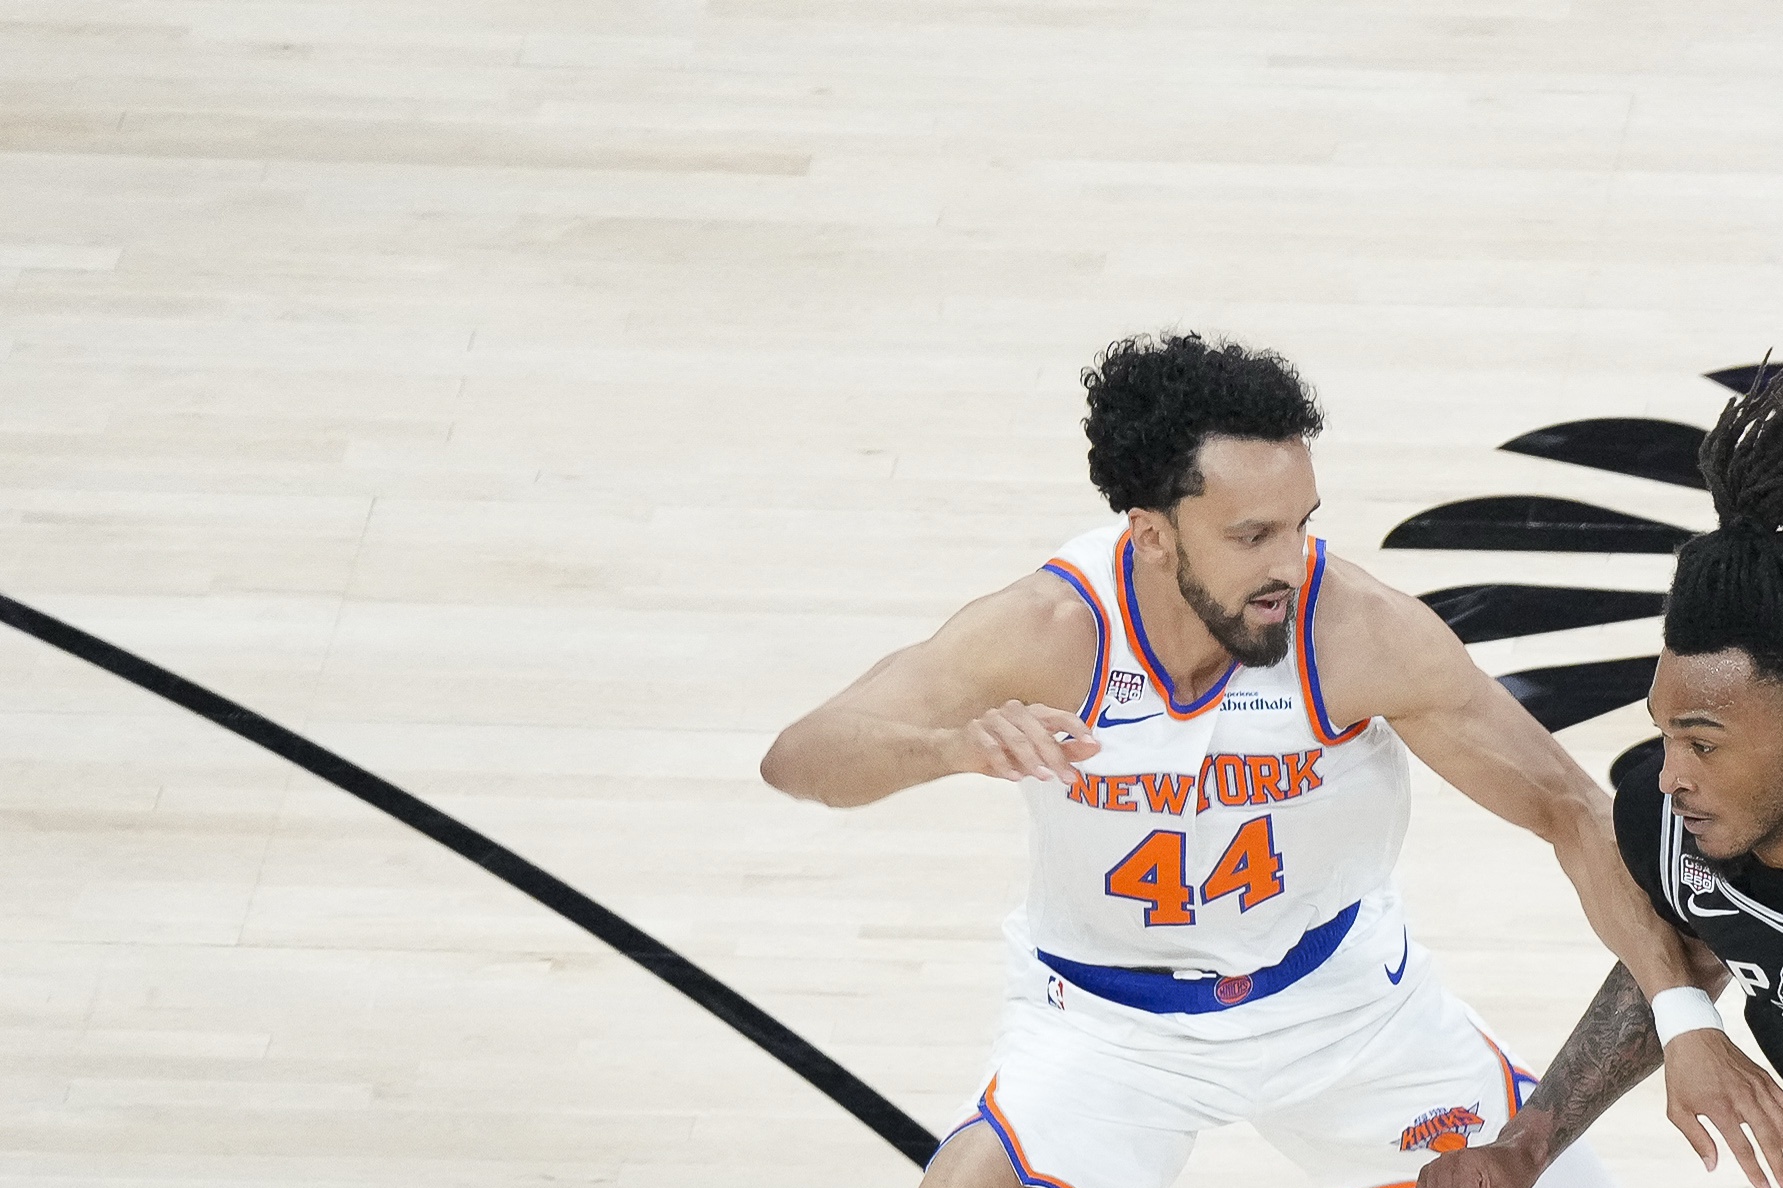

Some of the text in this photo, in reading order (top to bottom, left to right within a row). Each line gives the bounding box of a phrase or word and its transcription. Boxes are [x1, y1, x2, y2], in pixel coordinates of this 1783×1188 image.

[1249, 696, 1292, 711] dhabi
[1067, 773, 1196, 817] NEW
[1104, 813, 1286, 928] 44
[1399, 1105, 1485, 1151] KNICKS
